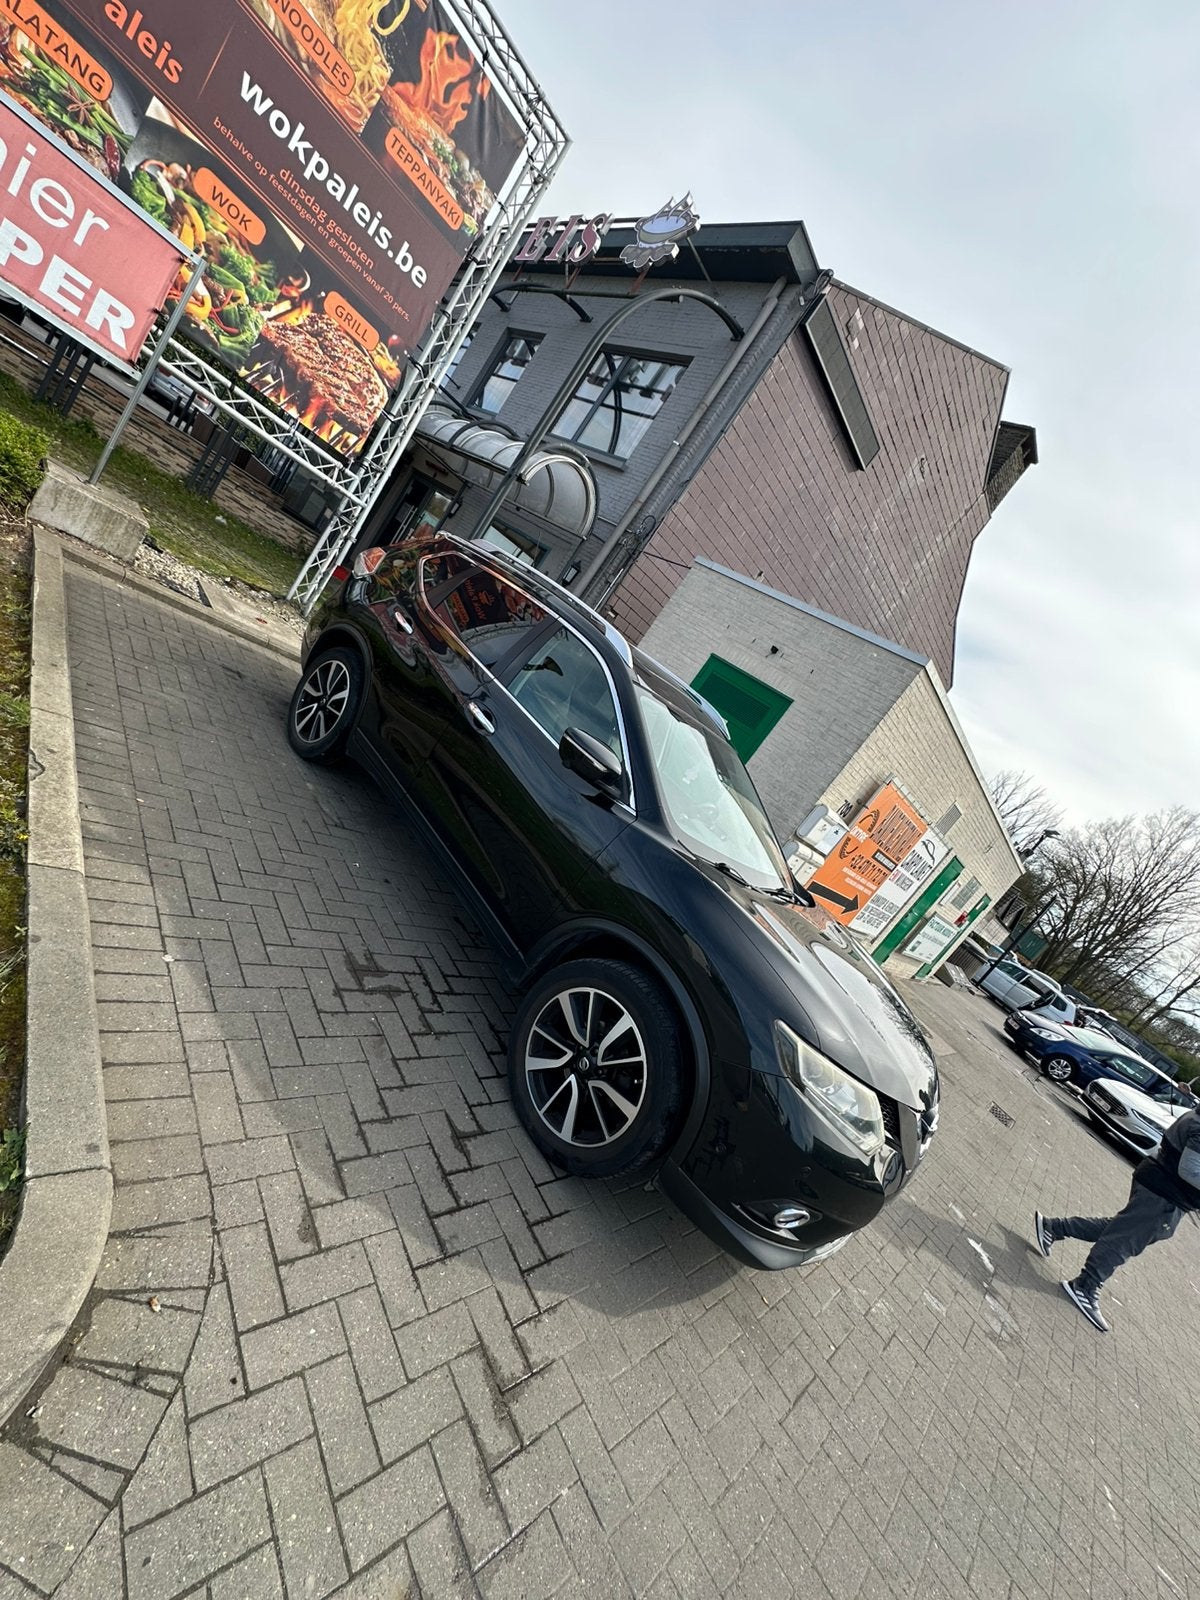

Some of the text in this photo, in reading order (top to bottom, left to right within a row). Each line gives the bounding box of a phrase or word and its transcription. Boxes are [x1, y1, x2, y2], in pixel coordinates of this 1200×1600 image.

[0, 136, 110, 247] ier
[210, 185, 252, 232] WOK
[212, 116, 411, 322] behalve op feestdagen en groepen vanaf 20 pers.
[240, 70, 428, 289] wokpaleis.be
[279, 167, 375, 269] dinsdag gesloten
[390, 133, 461, 226] TEPPANYAKI
[0, 217, 136, 351] PER
[334, 304, 370, 343] GRILL
